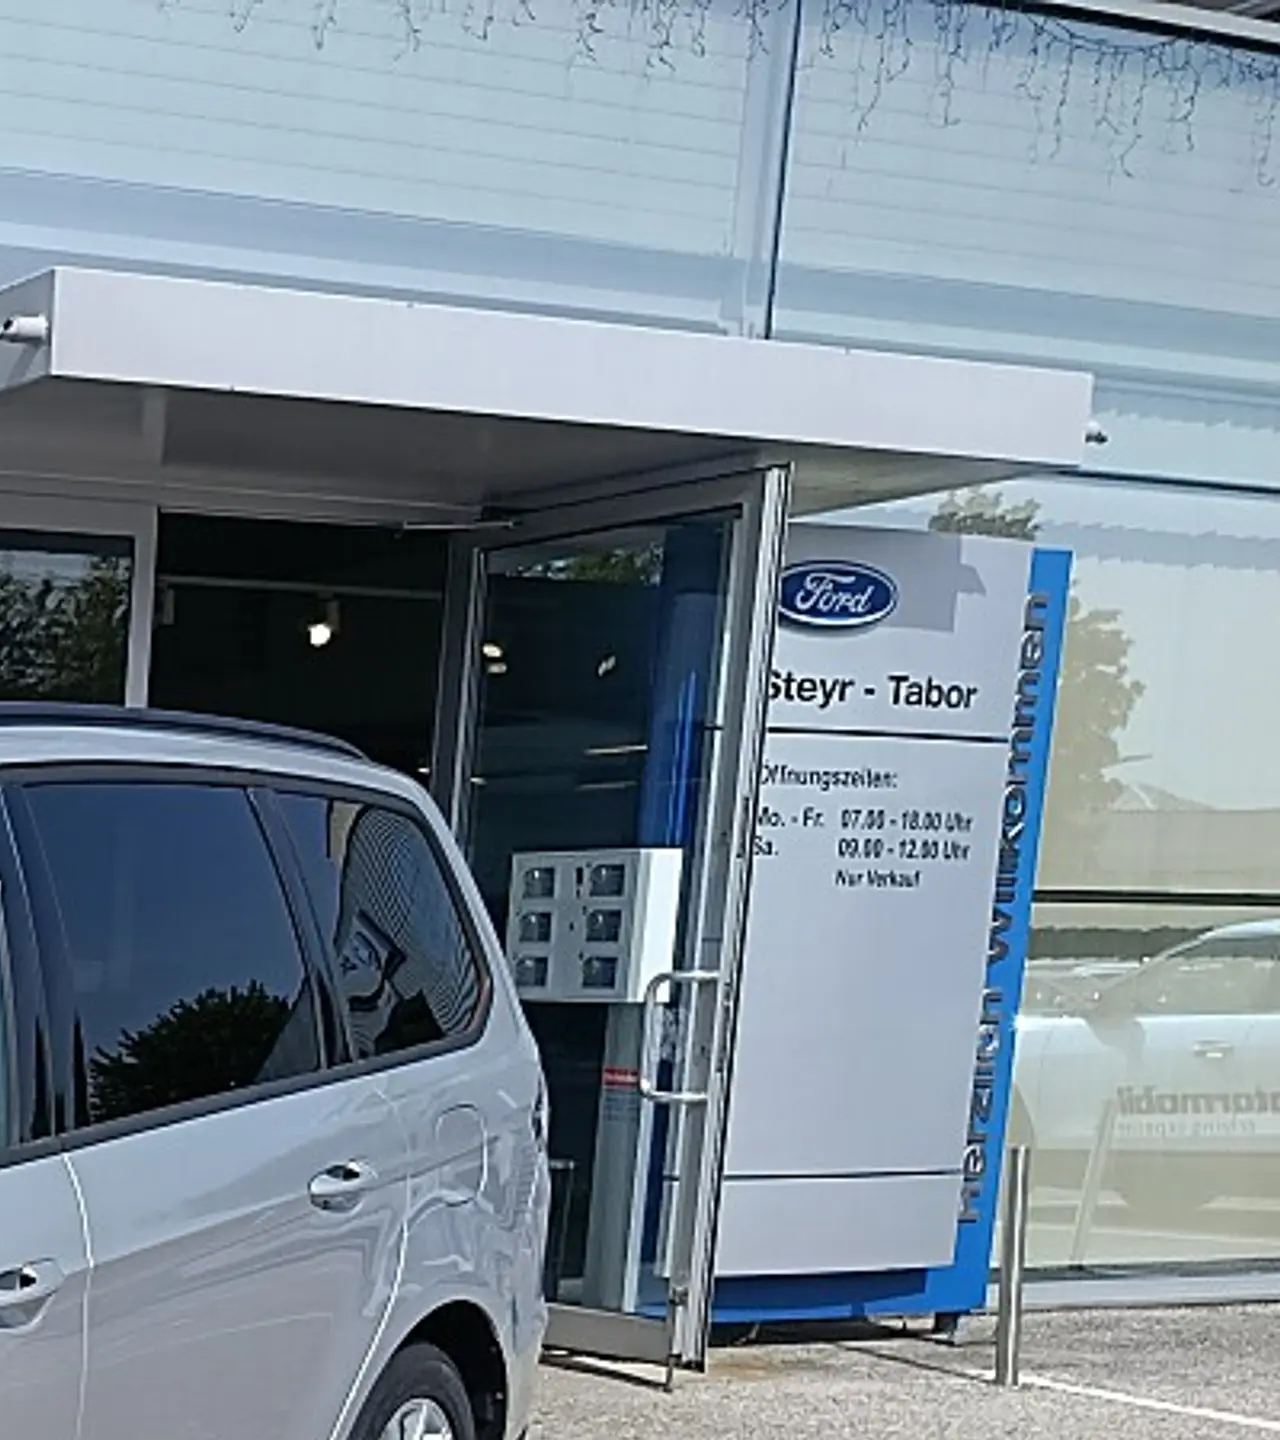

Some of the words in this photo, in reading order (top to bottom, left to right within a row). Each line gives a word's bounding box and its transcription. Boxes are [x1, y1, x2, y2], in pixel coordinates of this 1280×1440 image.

[794, 571, 876, 614] Ford
[888, 675, 979, 709] Tabor
[944, 811, 973, 832] Uhr
[943, 839, 971, 861] Uhr
